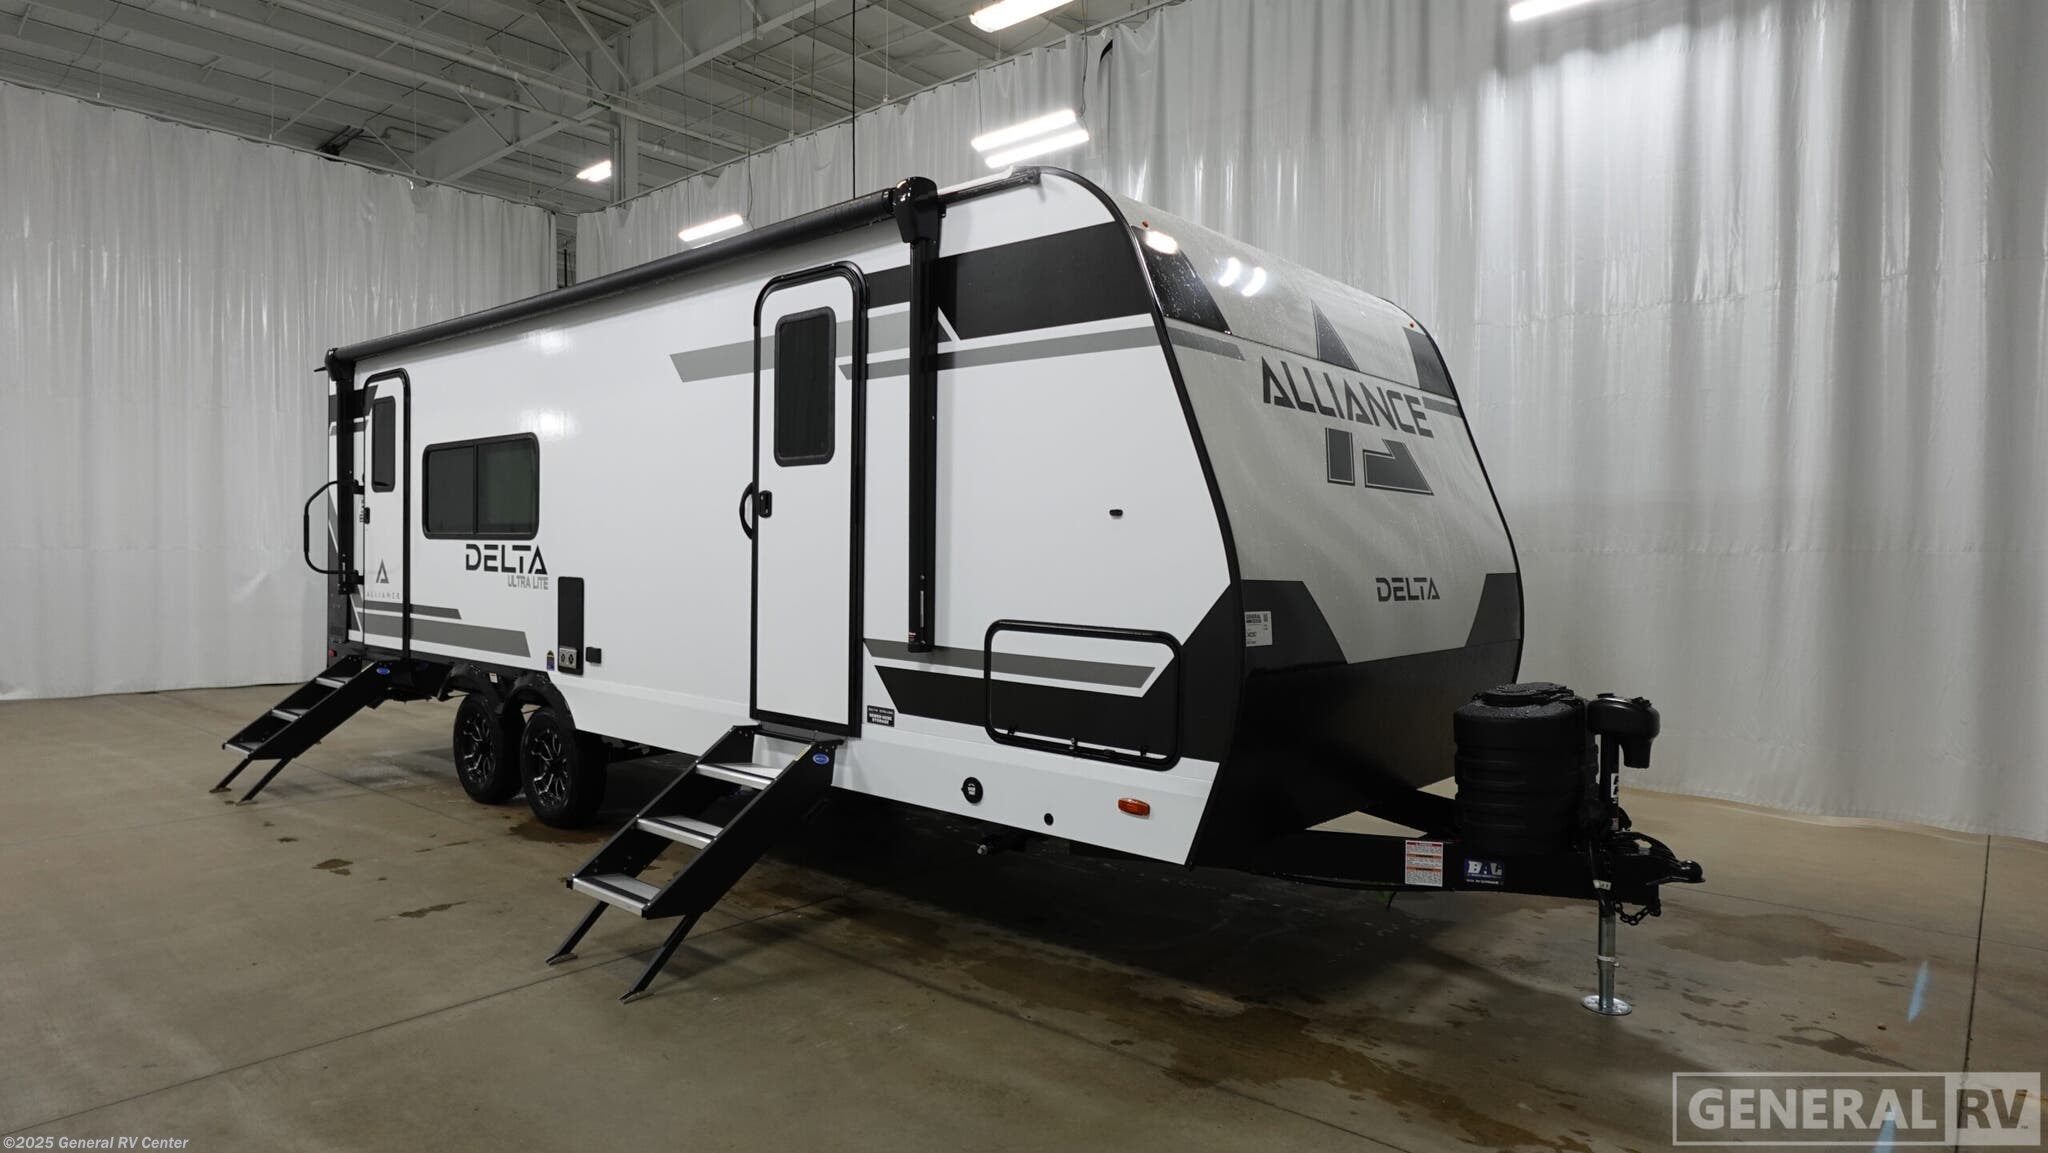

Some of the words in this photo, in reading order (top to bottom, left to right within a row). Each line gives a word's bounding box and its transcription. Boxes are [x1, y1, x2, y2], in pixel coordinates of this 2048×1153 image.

[1261, 355, 1434, 438] ALLIANCE
[466, 543, 548, 575] DELTA
[507, 575, 531, 589] ULTRA
[532, 576, 549, 590] LITE
[1375, 577, 1440, 602] DELTA
[366, 592, 400, 600] ALLIANCE
